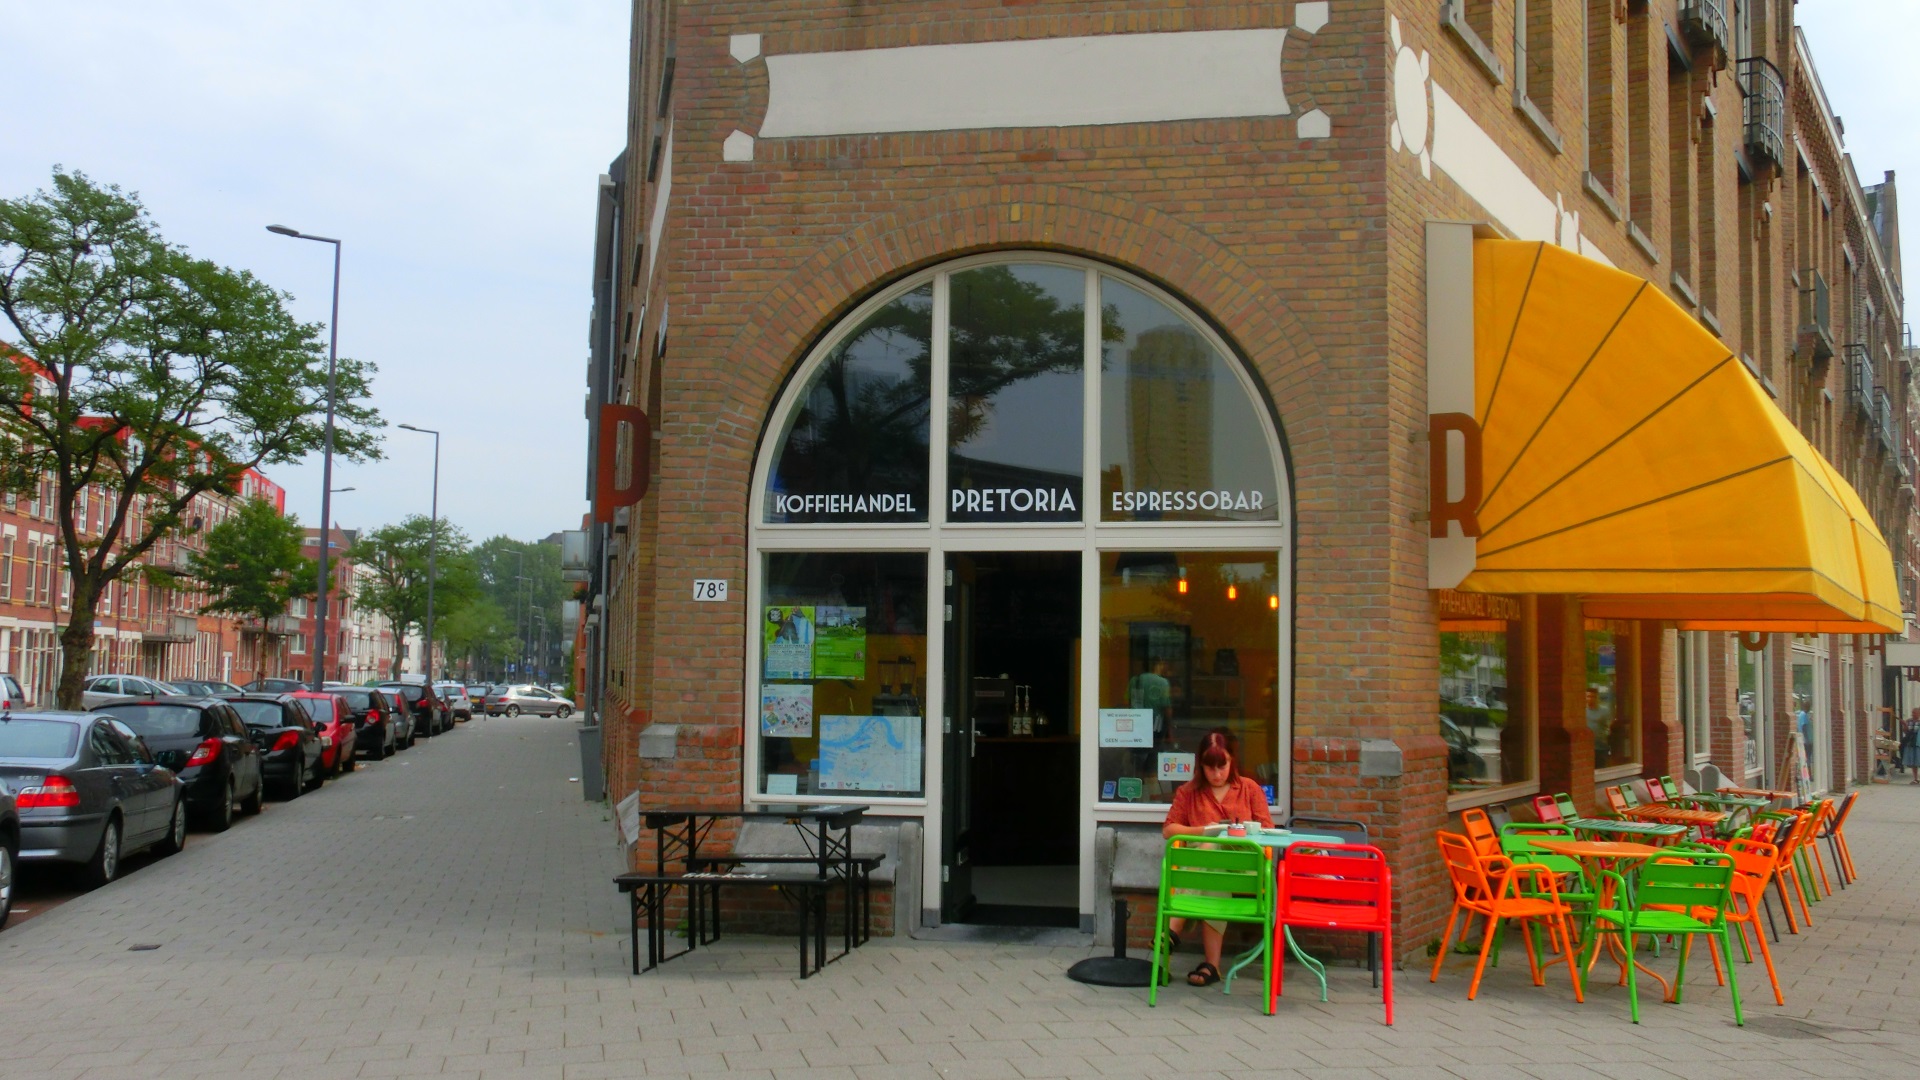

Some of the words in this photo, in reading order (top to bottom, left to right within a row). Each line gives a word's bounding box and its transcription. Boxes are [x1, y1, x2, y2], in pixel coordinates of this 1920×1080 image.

[1429, 412, 1483, 538] R
[776, 494, 916, 513] KOFFIEHANDEL
[952, 488, 1076, 512] PRETORIA
[1112, 491, 1263, 511] ESPRESSOBAR
[1164, 763, 1190, 773] OPEN
